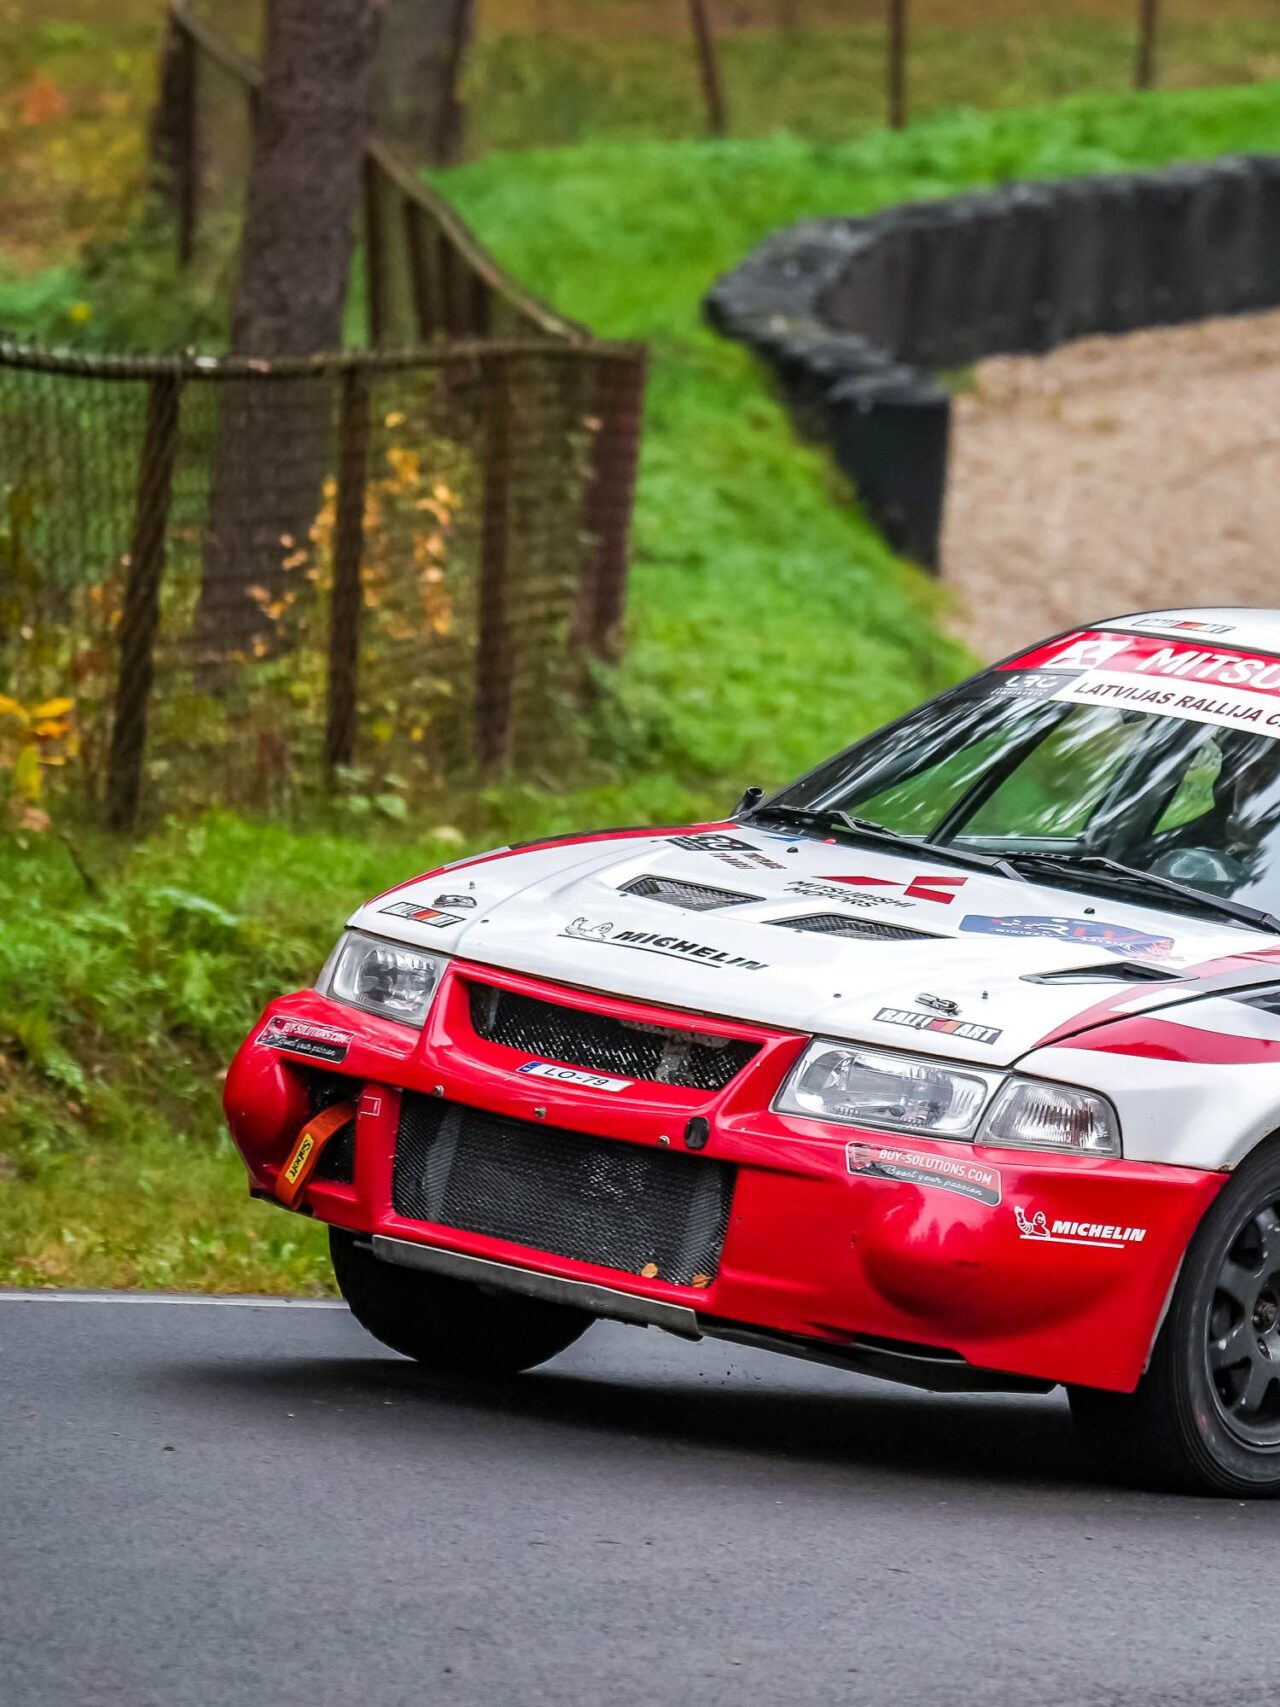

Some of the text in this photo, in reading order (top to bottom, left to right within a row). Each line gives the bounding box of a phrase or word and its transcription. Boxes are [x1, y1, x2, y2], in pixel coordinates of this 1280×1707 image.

[1074, 682, 1175, 704] LATVIJAS
[1174, 695, 1264, 722] RALLIJA
[612, 930, 769, 970] MICHELIN
[544, 1067, 609, 1086] LO-79
[879, 1149, 992, 1185] BUY-SOLUTIONS.COM
[881, 1165, 984, 1196] Boost your passion
[1051, 1219, 1147, 1242] MICHELIN
